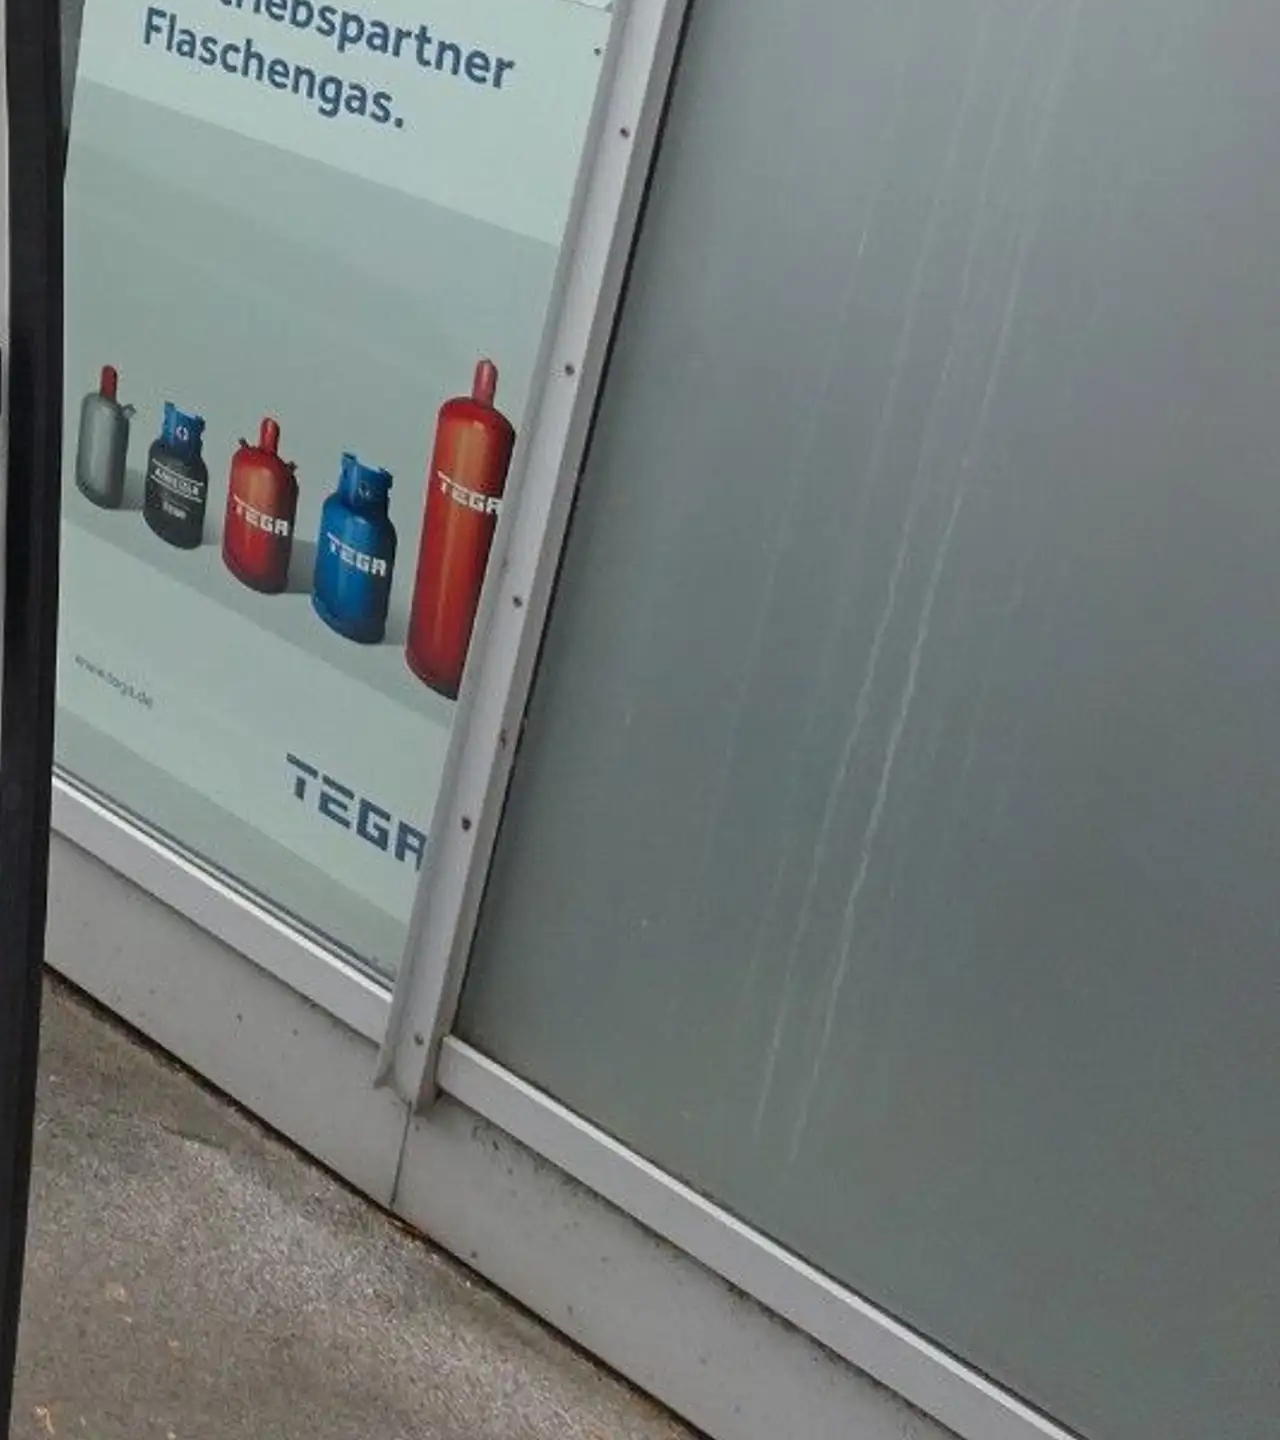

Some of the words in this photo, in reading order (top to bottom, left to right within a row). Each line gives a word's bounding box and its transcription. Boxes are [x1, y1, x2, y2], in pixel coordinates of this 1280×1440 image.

[143, 7, 405, 128] Flaschengas.
[233, 492, 289, 537] TEGA
[437, 470, 503, 514] TEGA
[327, 531, 388, 578] TEGA
[286, 752, 428, 872] TEGA
